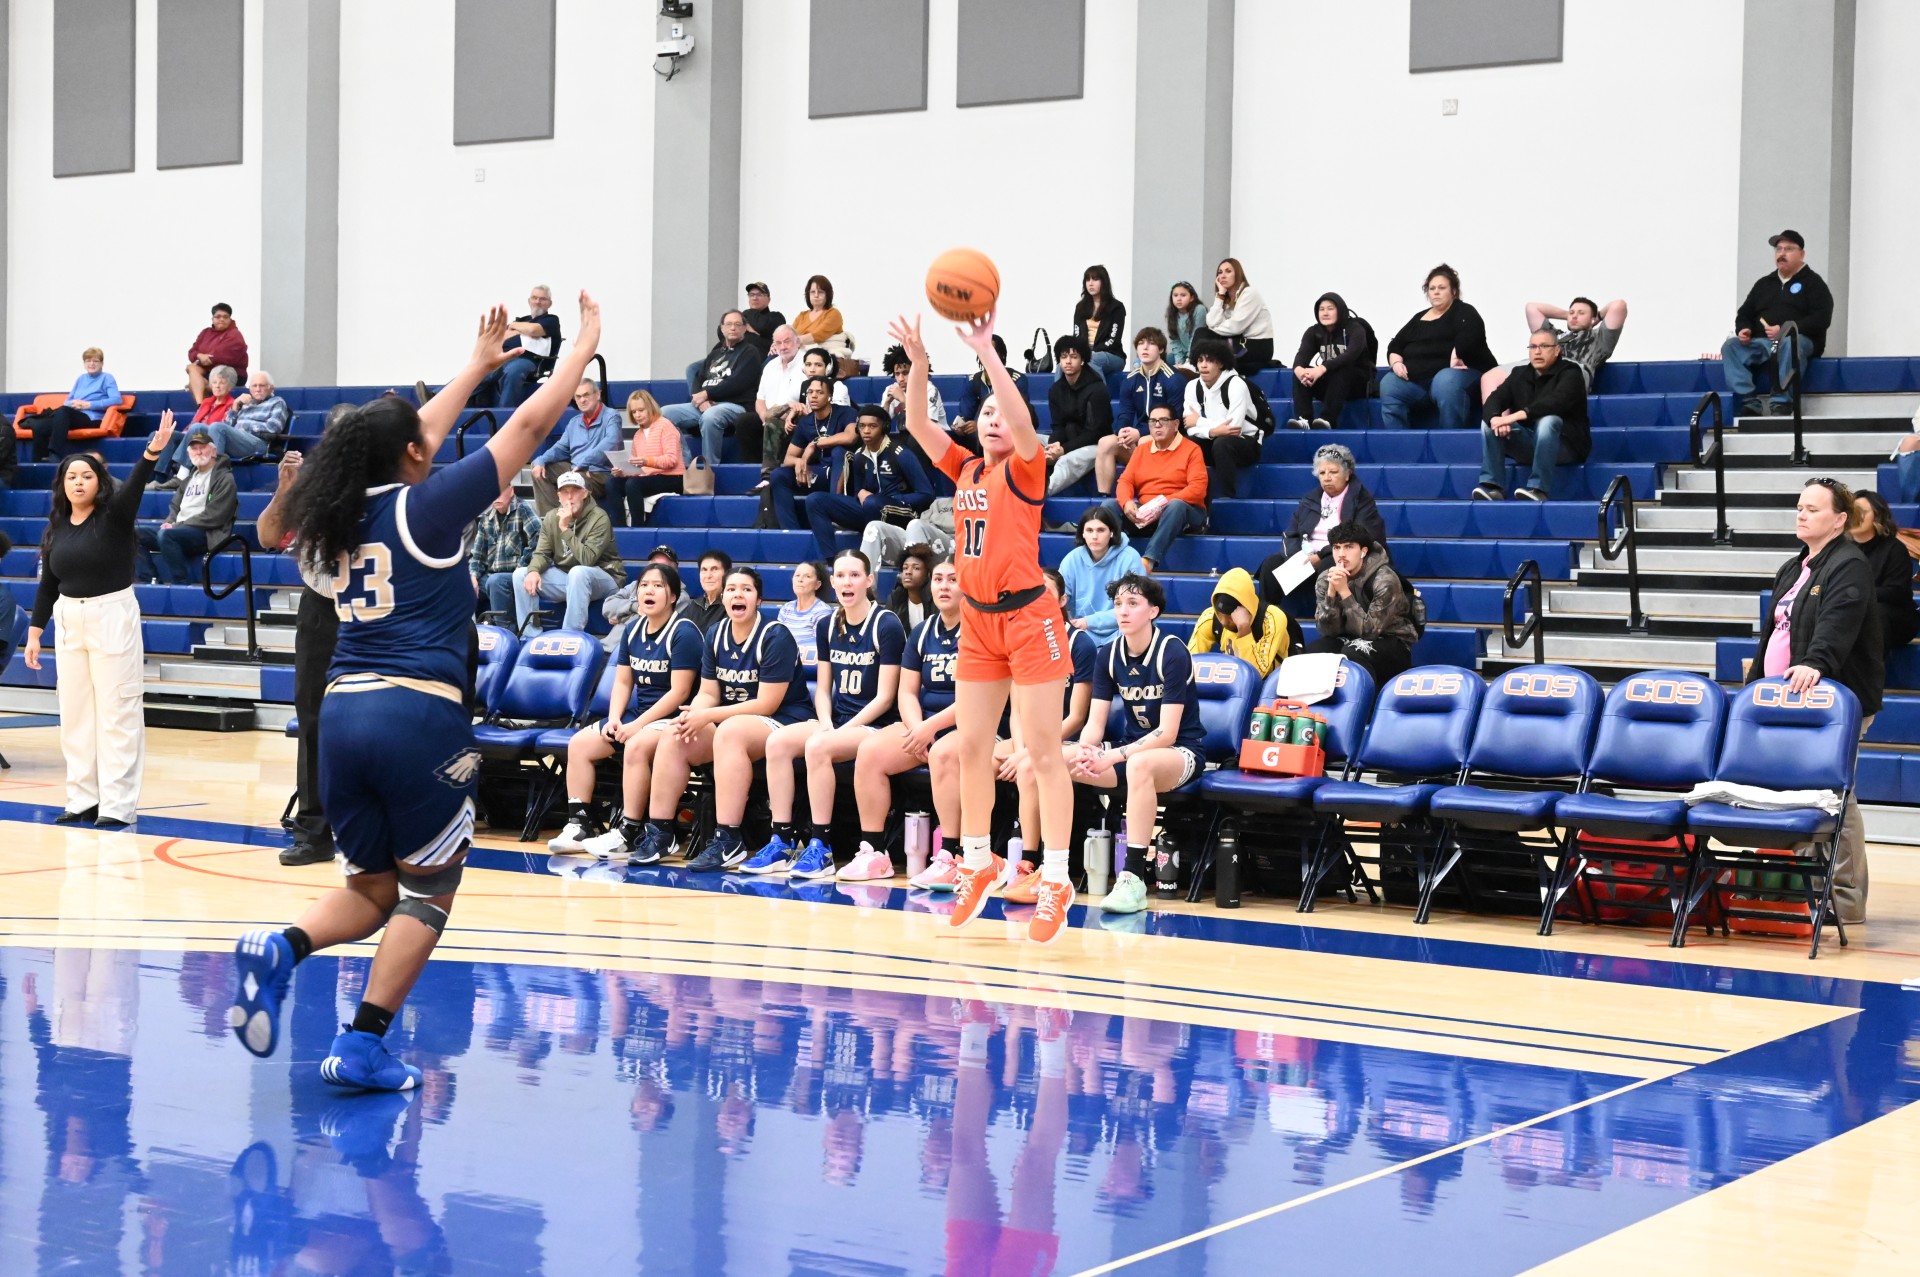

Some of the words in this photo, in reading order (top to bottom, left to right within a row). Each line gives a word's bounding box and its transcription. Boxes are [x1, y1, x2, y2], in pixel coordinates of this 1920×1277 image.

[957, 488, 989, 512] COS
[964, 517, 987, 558] 10
[530, 636, 583, 655] COS
[1043, 618, 1061, 661] GIANTS
[839, 669, 862, 695] 10
[931, 660, 957, 682] 24
[1193, 661, 1239, 684] OS
[1394, 673, 1464, 696] COS
[1503, 673, 1578, 698] COS
[1626, 679, 1705, 705] COS
[1753, 683, 1835, 709] COS
[1132, 705, 1151, 729] 5
[1262, 746, 1280, 767] G
